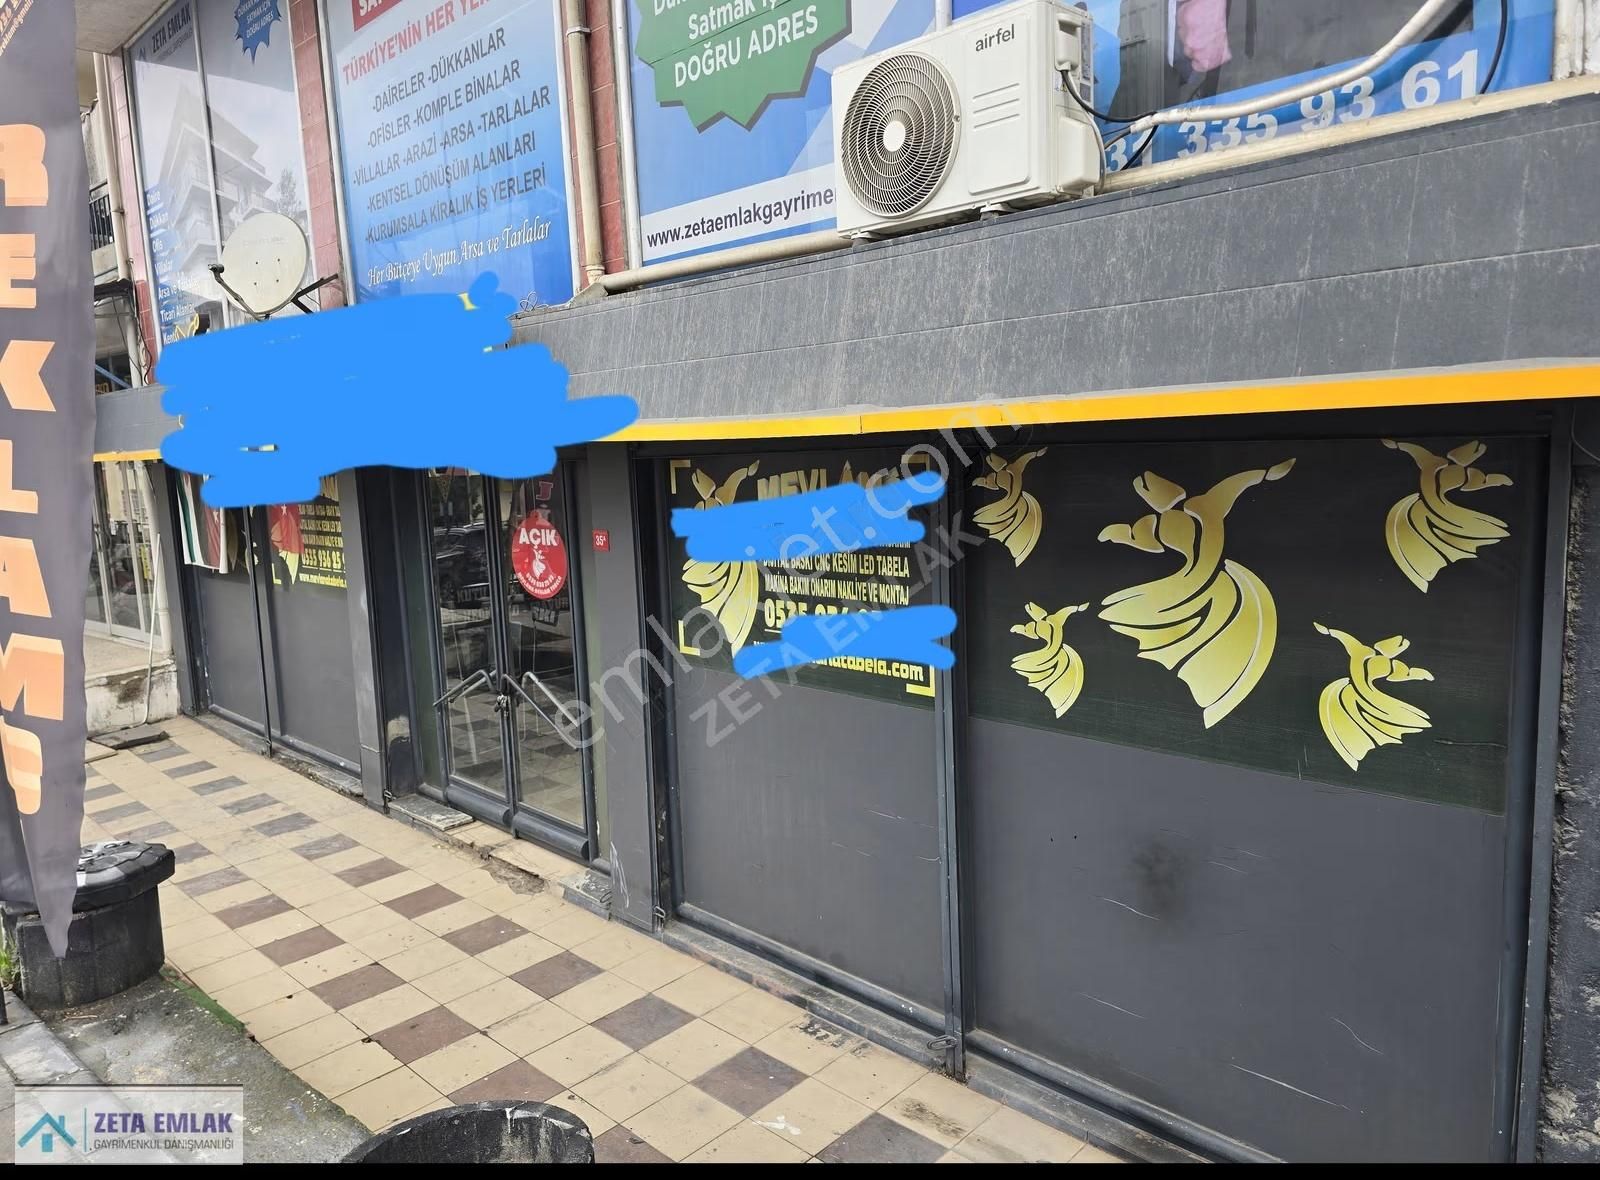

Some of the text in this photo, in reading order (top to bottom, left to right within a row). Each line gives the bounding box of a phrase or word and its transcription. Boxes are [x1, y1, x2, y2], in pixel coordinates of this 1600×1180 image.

[152, 29, 168, 53] ZETA
[167, 3, 192, 41] EMLAK
[343, 20, 422, 86] TÜRKİYE'NİN
[425, 0, 456, 37] HER
[674, 5, 819, 88] DOĞRU ADRES
[688, 0, 757, 41] Satmak
[975, 23, 1017, 52] airfel
[367, 59, 521, 149] -OFİSLER -KOMPLE BİNALAR
[372, 27, 507, 114] -DAİRELER -DÜKKANLAR
[1178, 112, 1279, 159] 335
[1300, 75, 1376, 134] 93
[1401, 48, 1481, 109] 61
[403, 131, 438, 167] -ARAZİ
[440, 119, 476, 150] -ARSA
[477, 85, 551, 133] -TARLALAR
[365, 213, 429, 246] -KURUMSALA
[430, 191, 474, 225] KİRALIK
[491, 161, 547, 203] YERLERİ
[367, 130, 536, 214] -KENTSEL DÖNÜŞÜM ALANLARI
[367, 215, 552, 288] Her Bütçeye Uygun Arsa ve Tarlalar
[647, 187, 836, 249] www.zetaemlakgayrime
[160, 306, 176, 323] Ticari
[519, 527, 559, 549] AÇIK
[815, 552, 831, 571] CNC
[832, 549, 857, 574] KESİM
[859, 554, 875, 575] LED
[877, 555, 910, 578] TABELA
[765, 571, 910, 606] MAKİNA BAKIM ONARIM NAKLİYE VE MONTAJ
